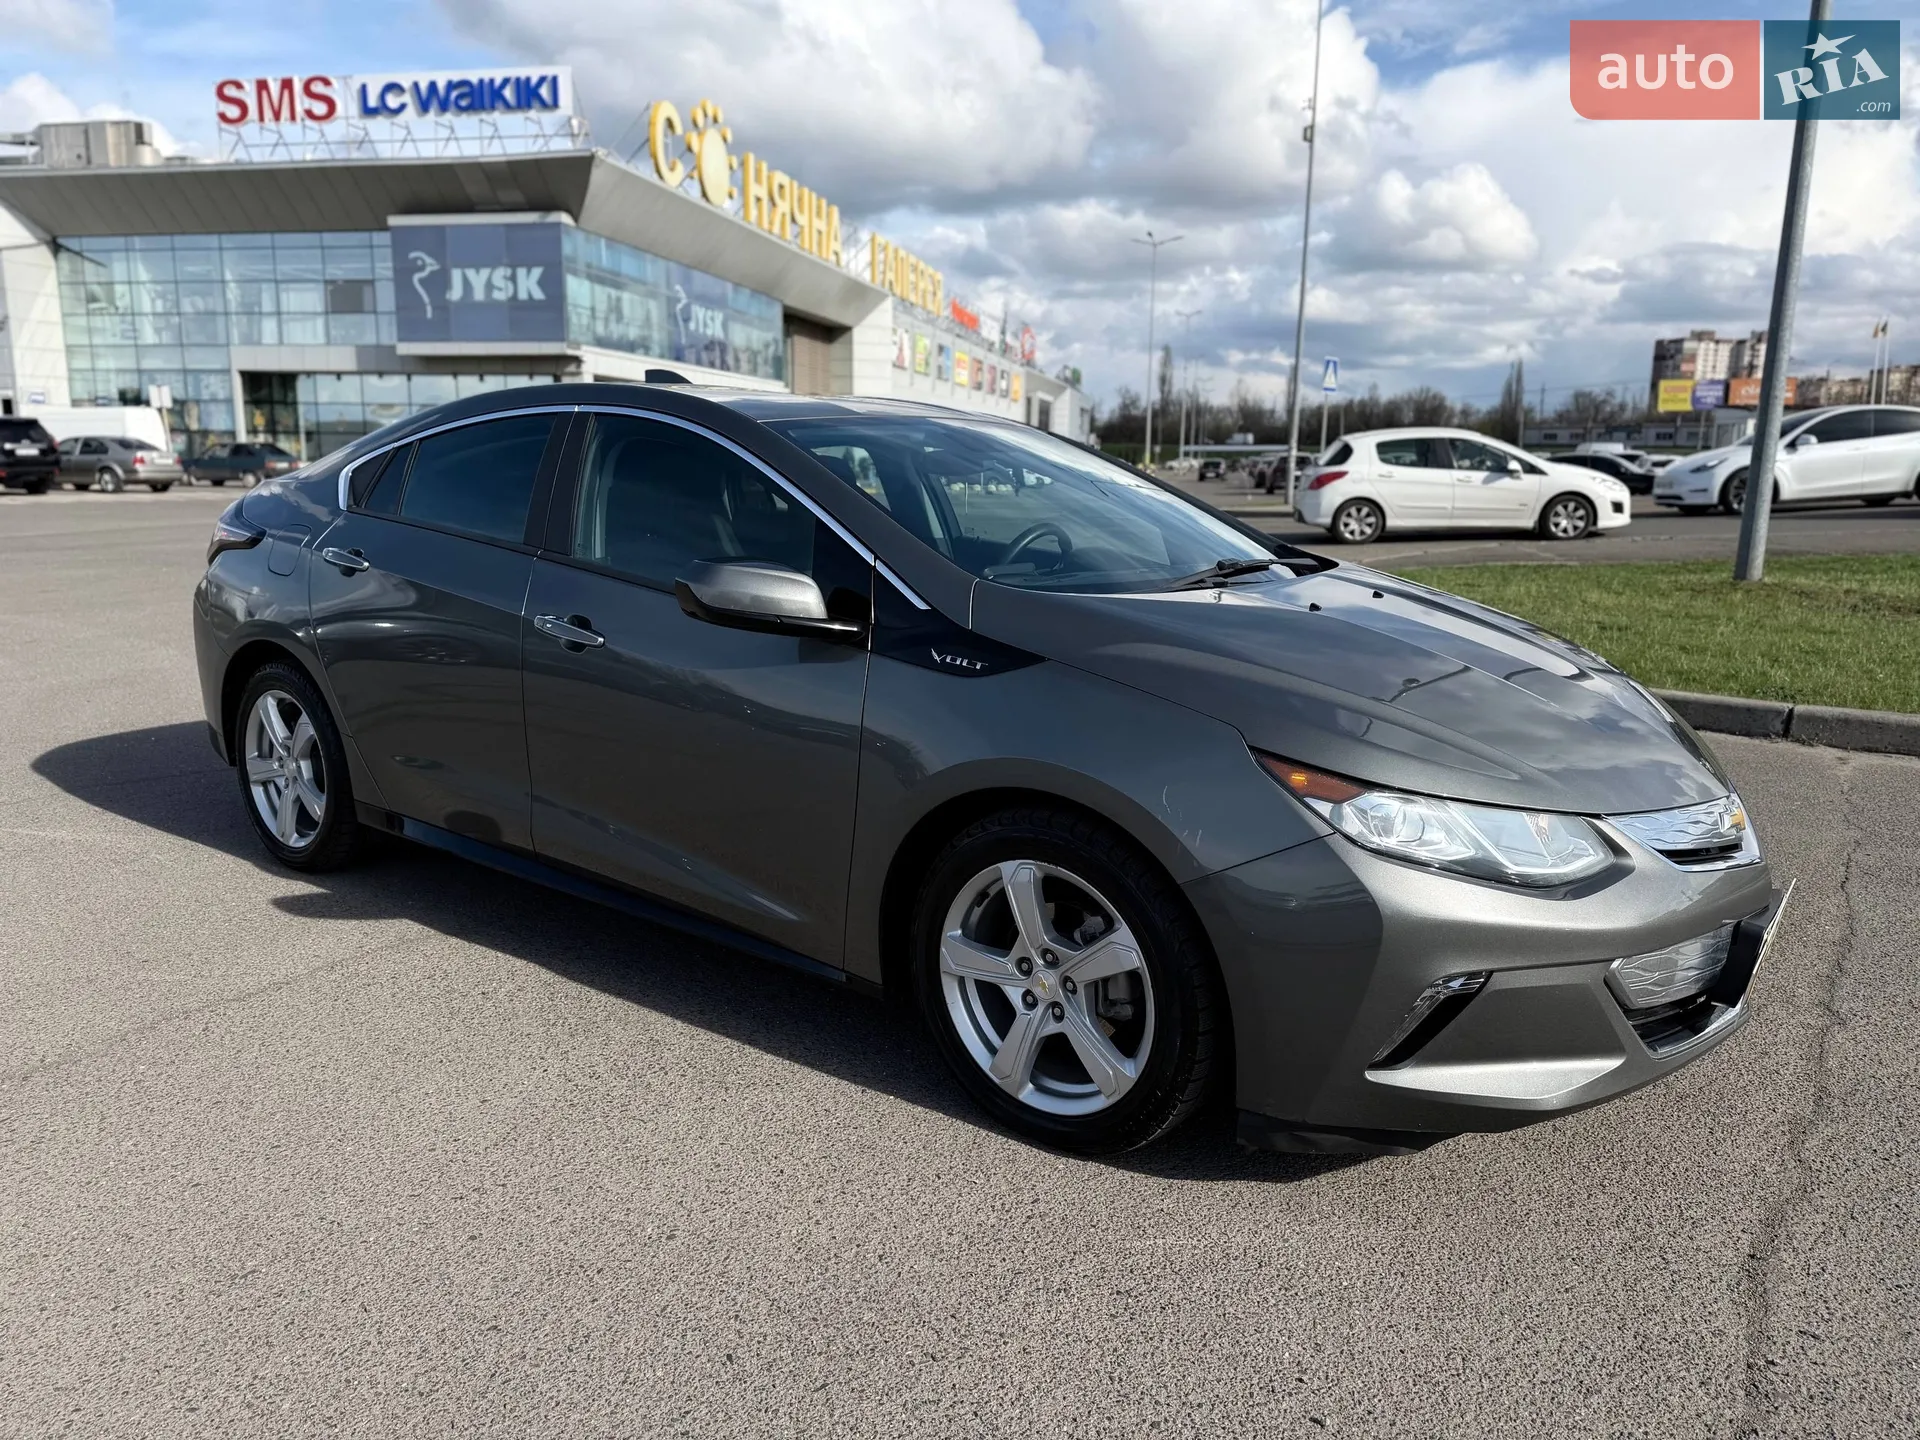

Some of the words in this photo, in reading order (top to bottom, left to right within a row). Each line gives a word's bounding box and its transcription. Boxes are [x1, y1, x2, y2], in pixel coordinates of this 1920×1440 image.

[215, 75, 338, 125] SMS
[359, 82, 407, 116] LC
[446, 266, 546, 301] JYSK
[689, 305, 725, 337] JYSK
[931, 648, 989, 670] VOLT
